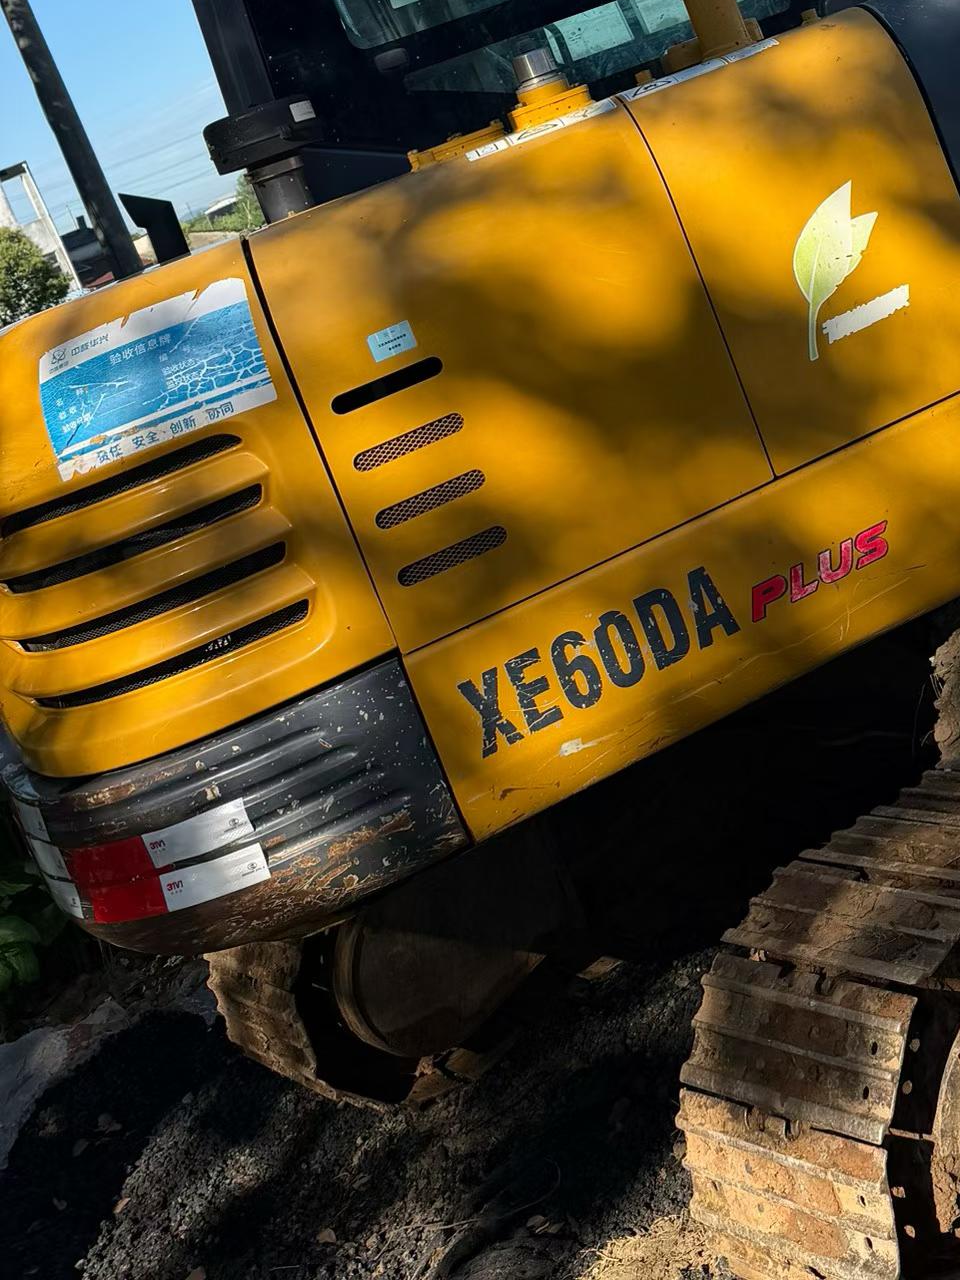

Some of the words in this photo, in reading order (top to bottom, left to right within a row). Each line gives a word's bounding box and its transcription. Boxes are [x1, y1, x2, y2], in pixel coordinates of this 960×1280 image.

[109, 333, 172, 366] 验收信息牌
[131, 430, 160, 450] 安全
[169, 415, 198, 434] 创新
[457, 566, 741, 759] XE60DA
[751, 519, 889, 623] PLUS
